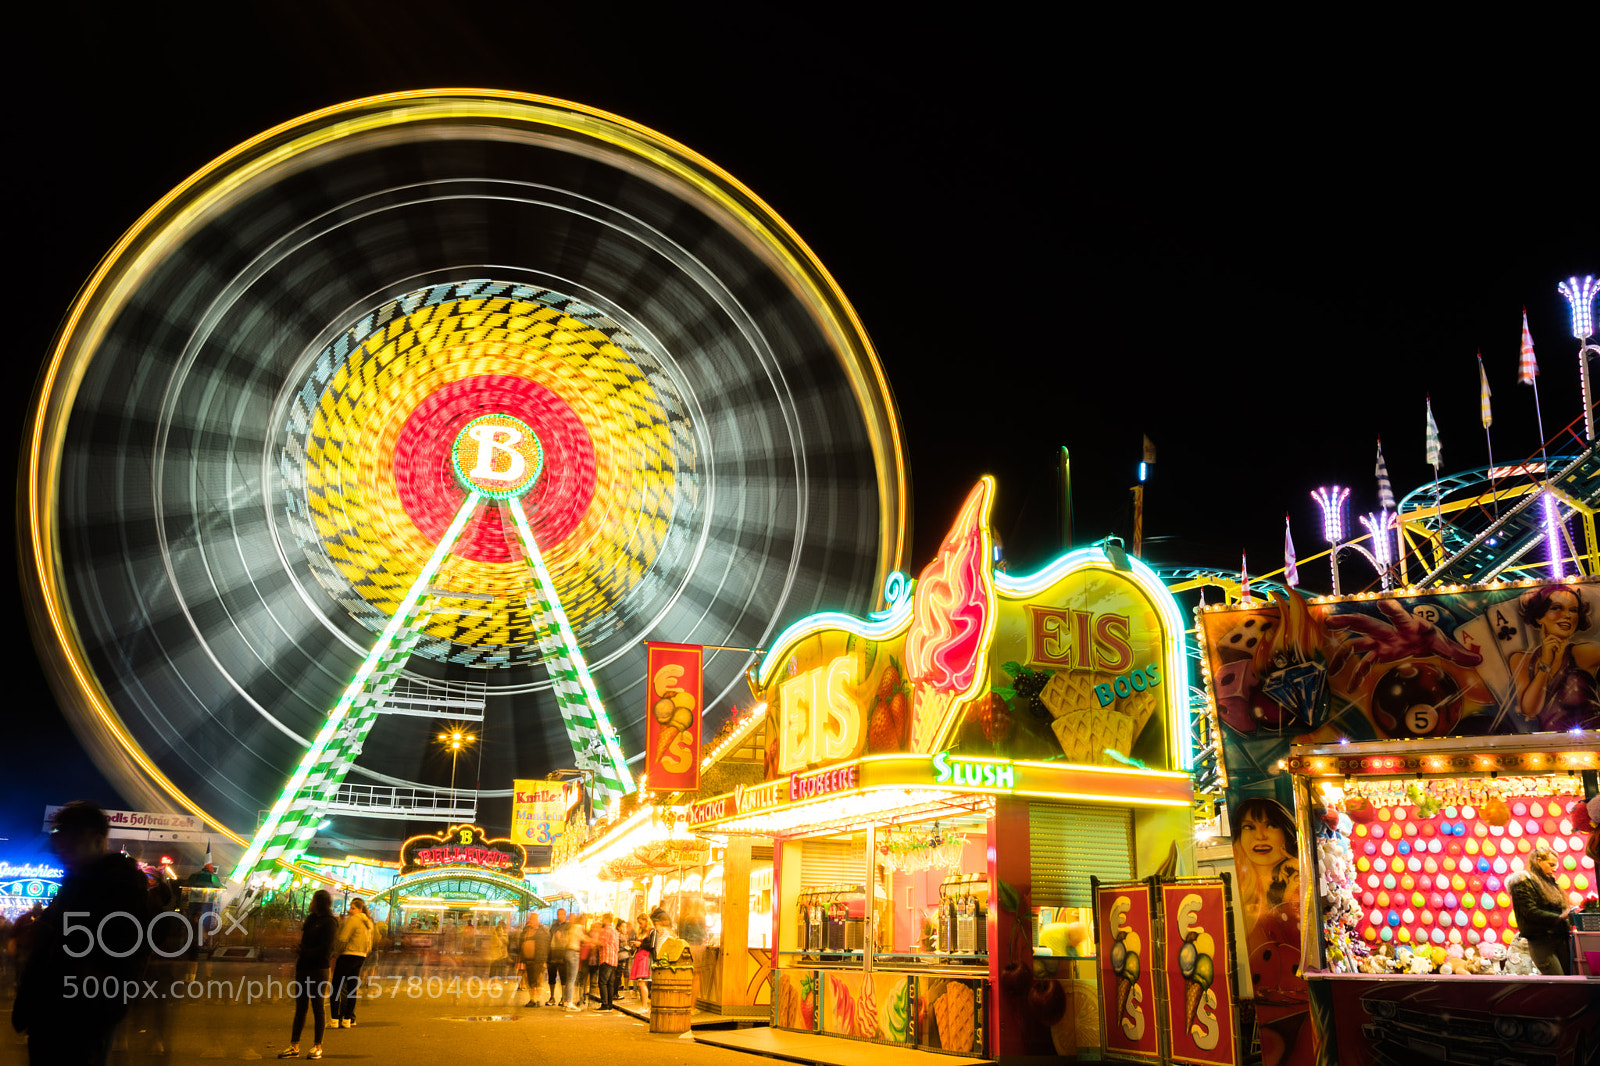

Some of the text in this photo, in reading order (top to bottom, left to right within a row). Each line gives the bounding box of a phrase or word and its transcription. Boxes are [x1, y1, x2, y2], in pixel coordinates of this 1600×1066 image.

[468, 425, 525, 482] B
[1023, 604, 1135, 674] EIS
[1094, 662, 1162, 707] BOOS
[778, 654, 860, 774] EIS
[1415, 711, 1429, 729] 5
[130, 814, 169, 826] Hofbräu
[171, 817, 195, 828] Zelt
[516, 810, 563, 821] Mandeln
[460, 830, 473, 845] B
[418, 848, 510, 869] BELLEVUE
